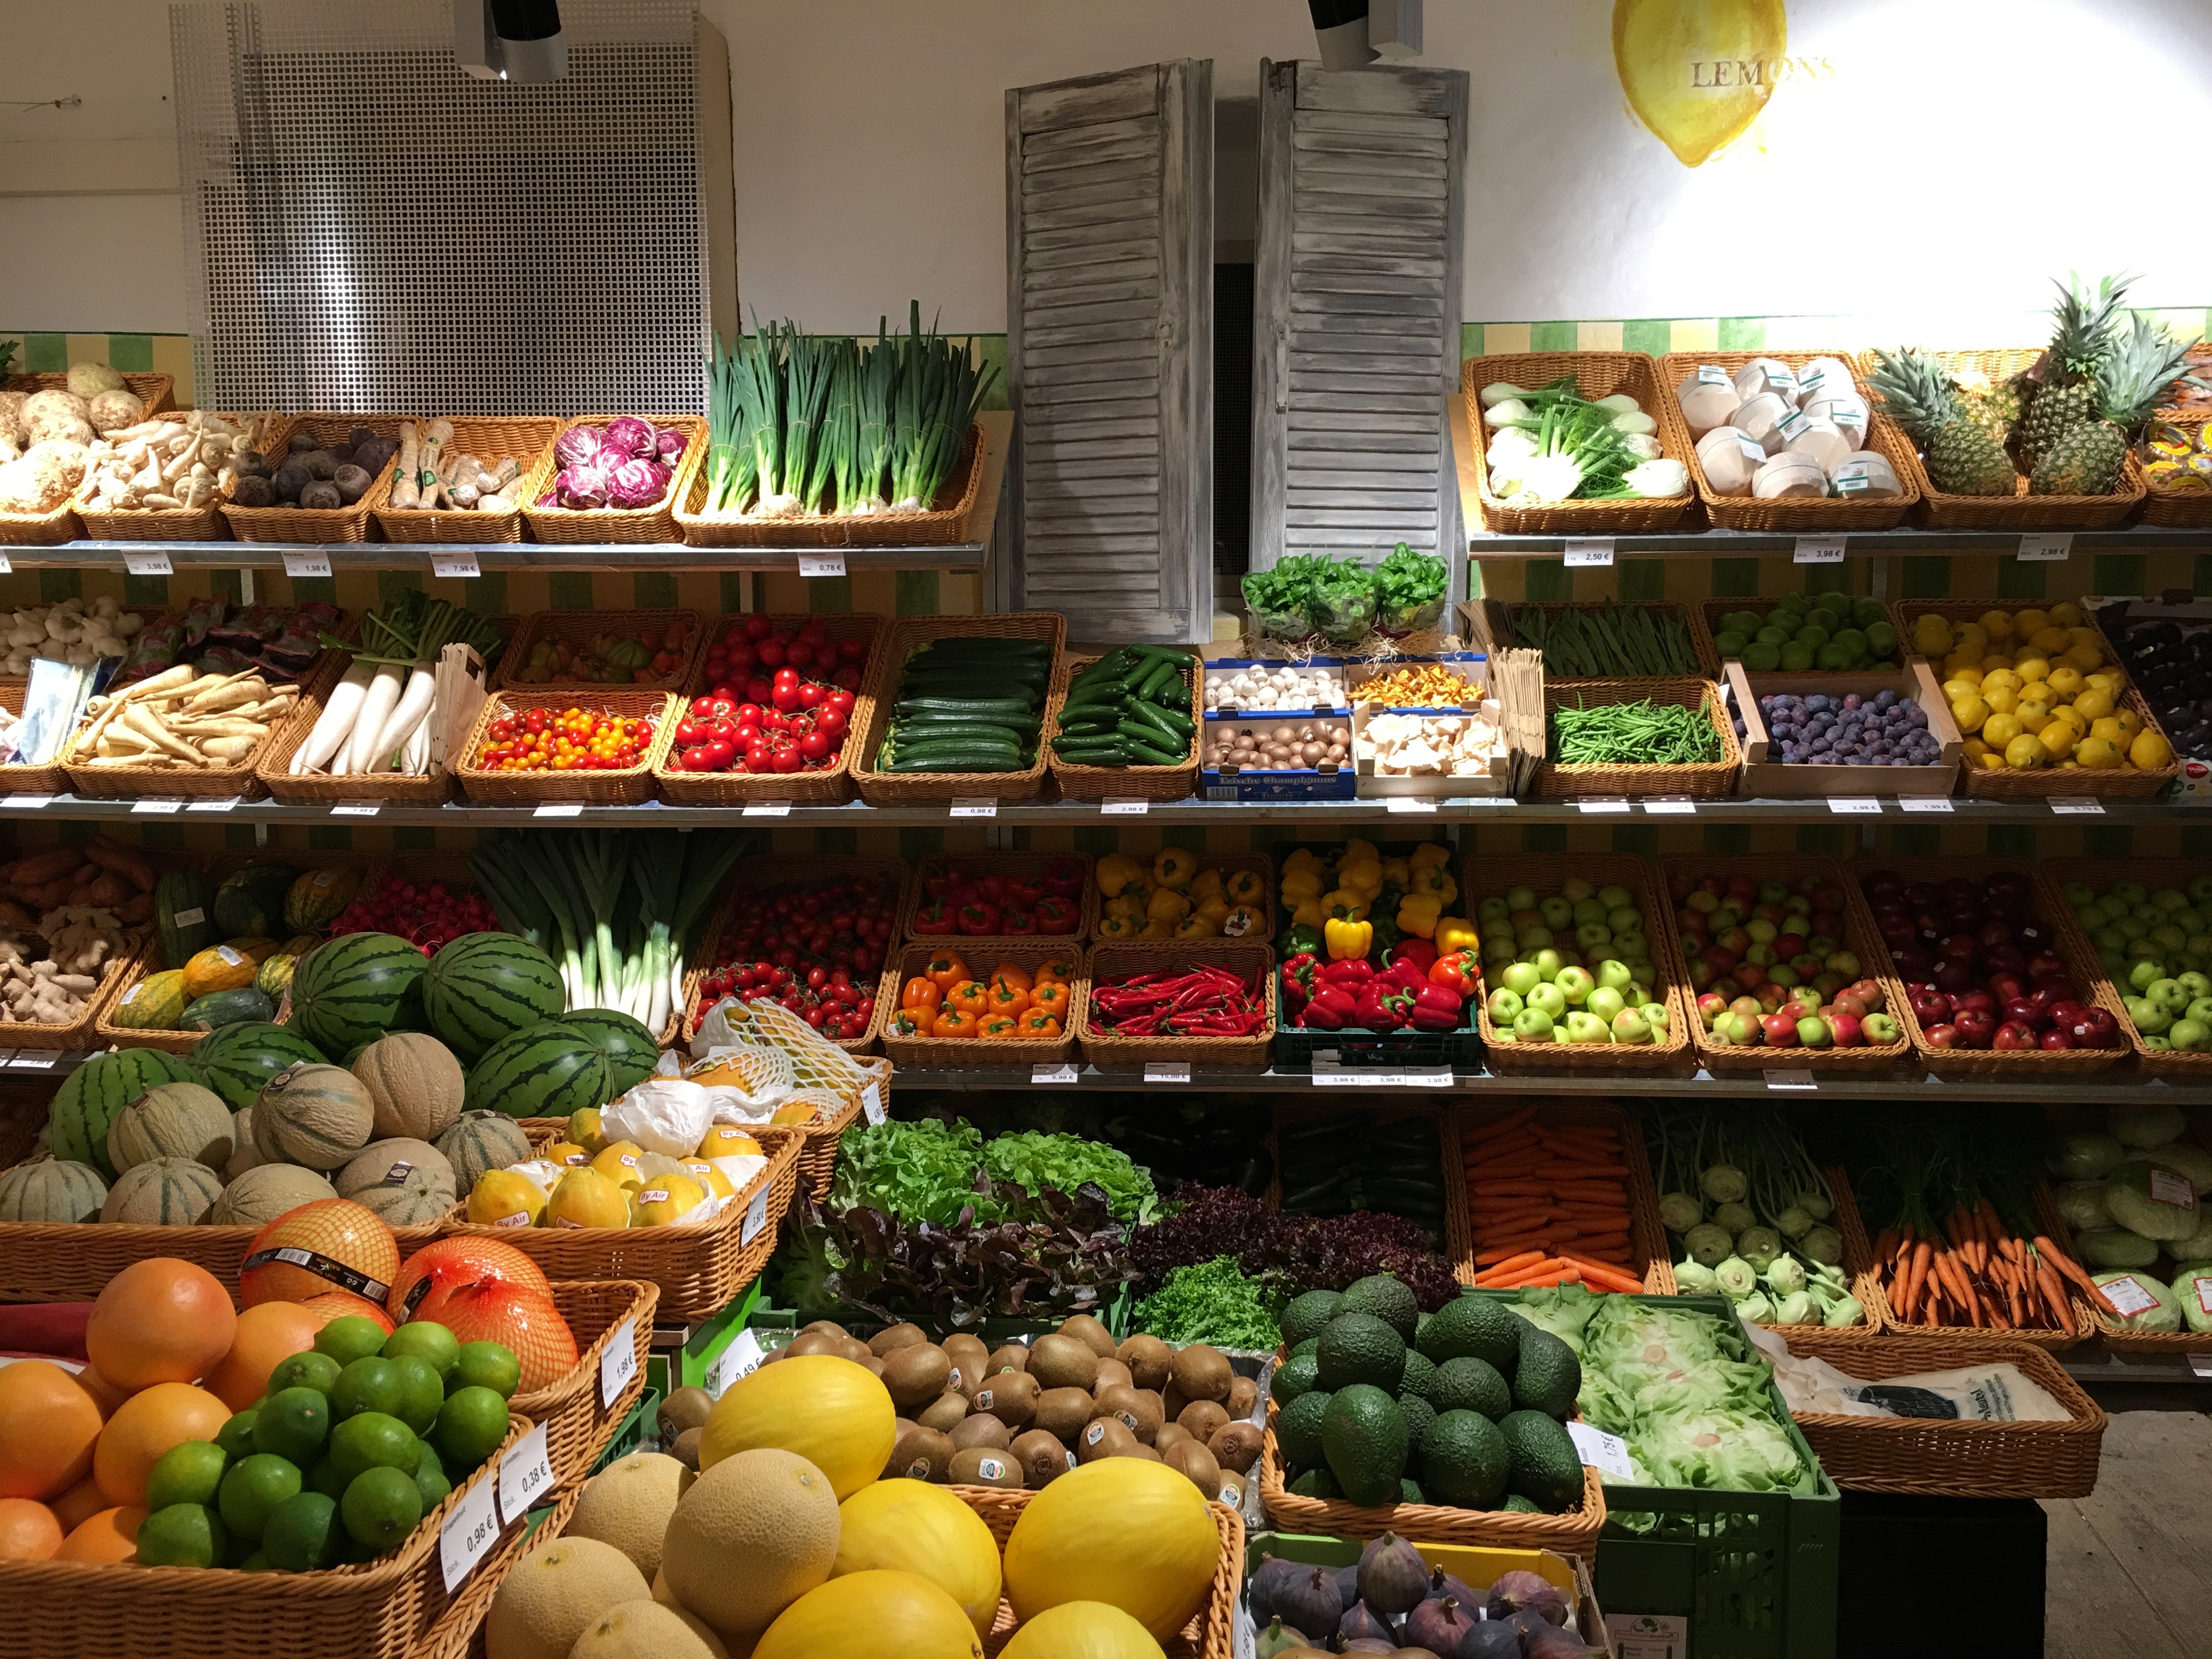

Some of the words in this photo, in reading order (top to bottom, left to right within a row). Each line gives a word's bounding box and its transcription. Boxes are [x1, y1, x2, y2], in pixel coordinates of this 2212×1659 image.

[1691, 57, 1836, 88] LEMONS
[1262, 775, 1337, 787] Champignons
[624, 1156, 635, 1164] By
[640, 1193, 650, 1201] By
[497, 1220, 509, 1228] By
[512, 1214, 526, 1226] Air
[761, 1207, 765, 1218] €
[617, 1358, 628, 1379] 1,98
[629, 1351, 633, 1365] €
[1580, 1447, 1590, 1464] Avocado
[1602, 1441, 1620, 1458] 1,75
[522, 1468, 540, 1492] 0,38
[540, 1461, 547, 1476] €
[503, 1496, 516, 1510] Stck.
[443, 1505, 466, 1535] Grapefruit
[467, 1522, 486, 1552] 0,98
[487, 1513, 493, 1530] €
[446, 1559, 461, 1577] Stck.
